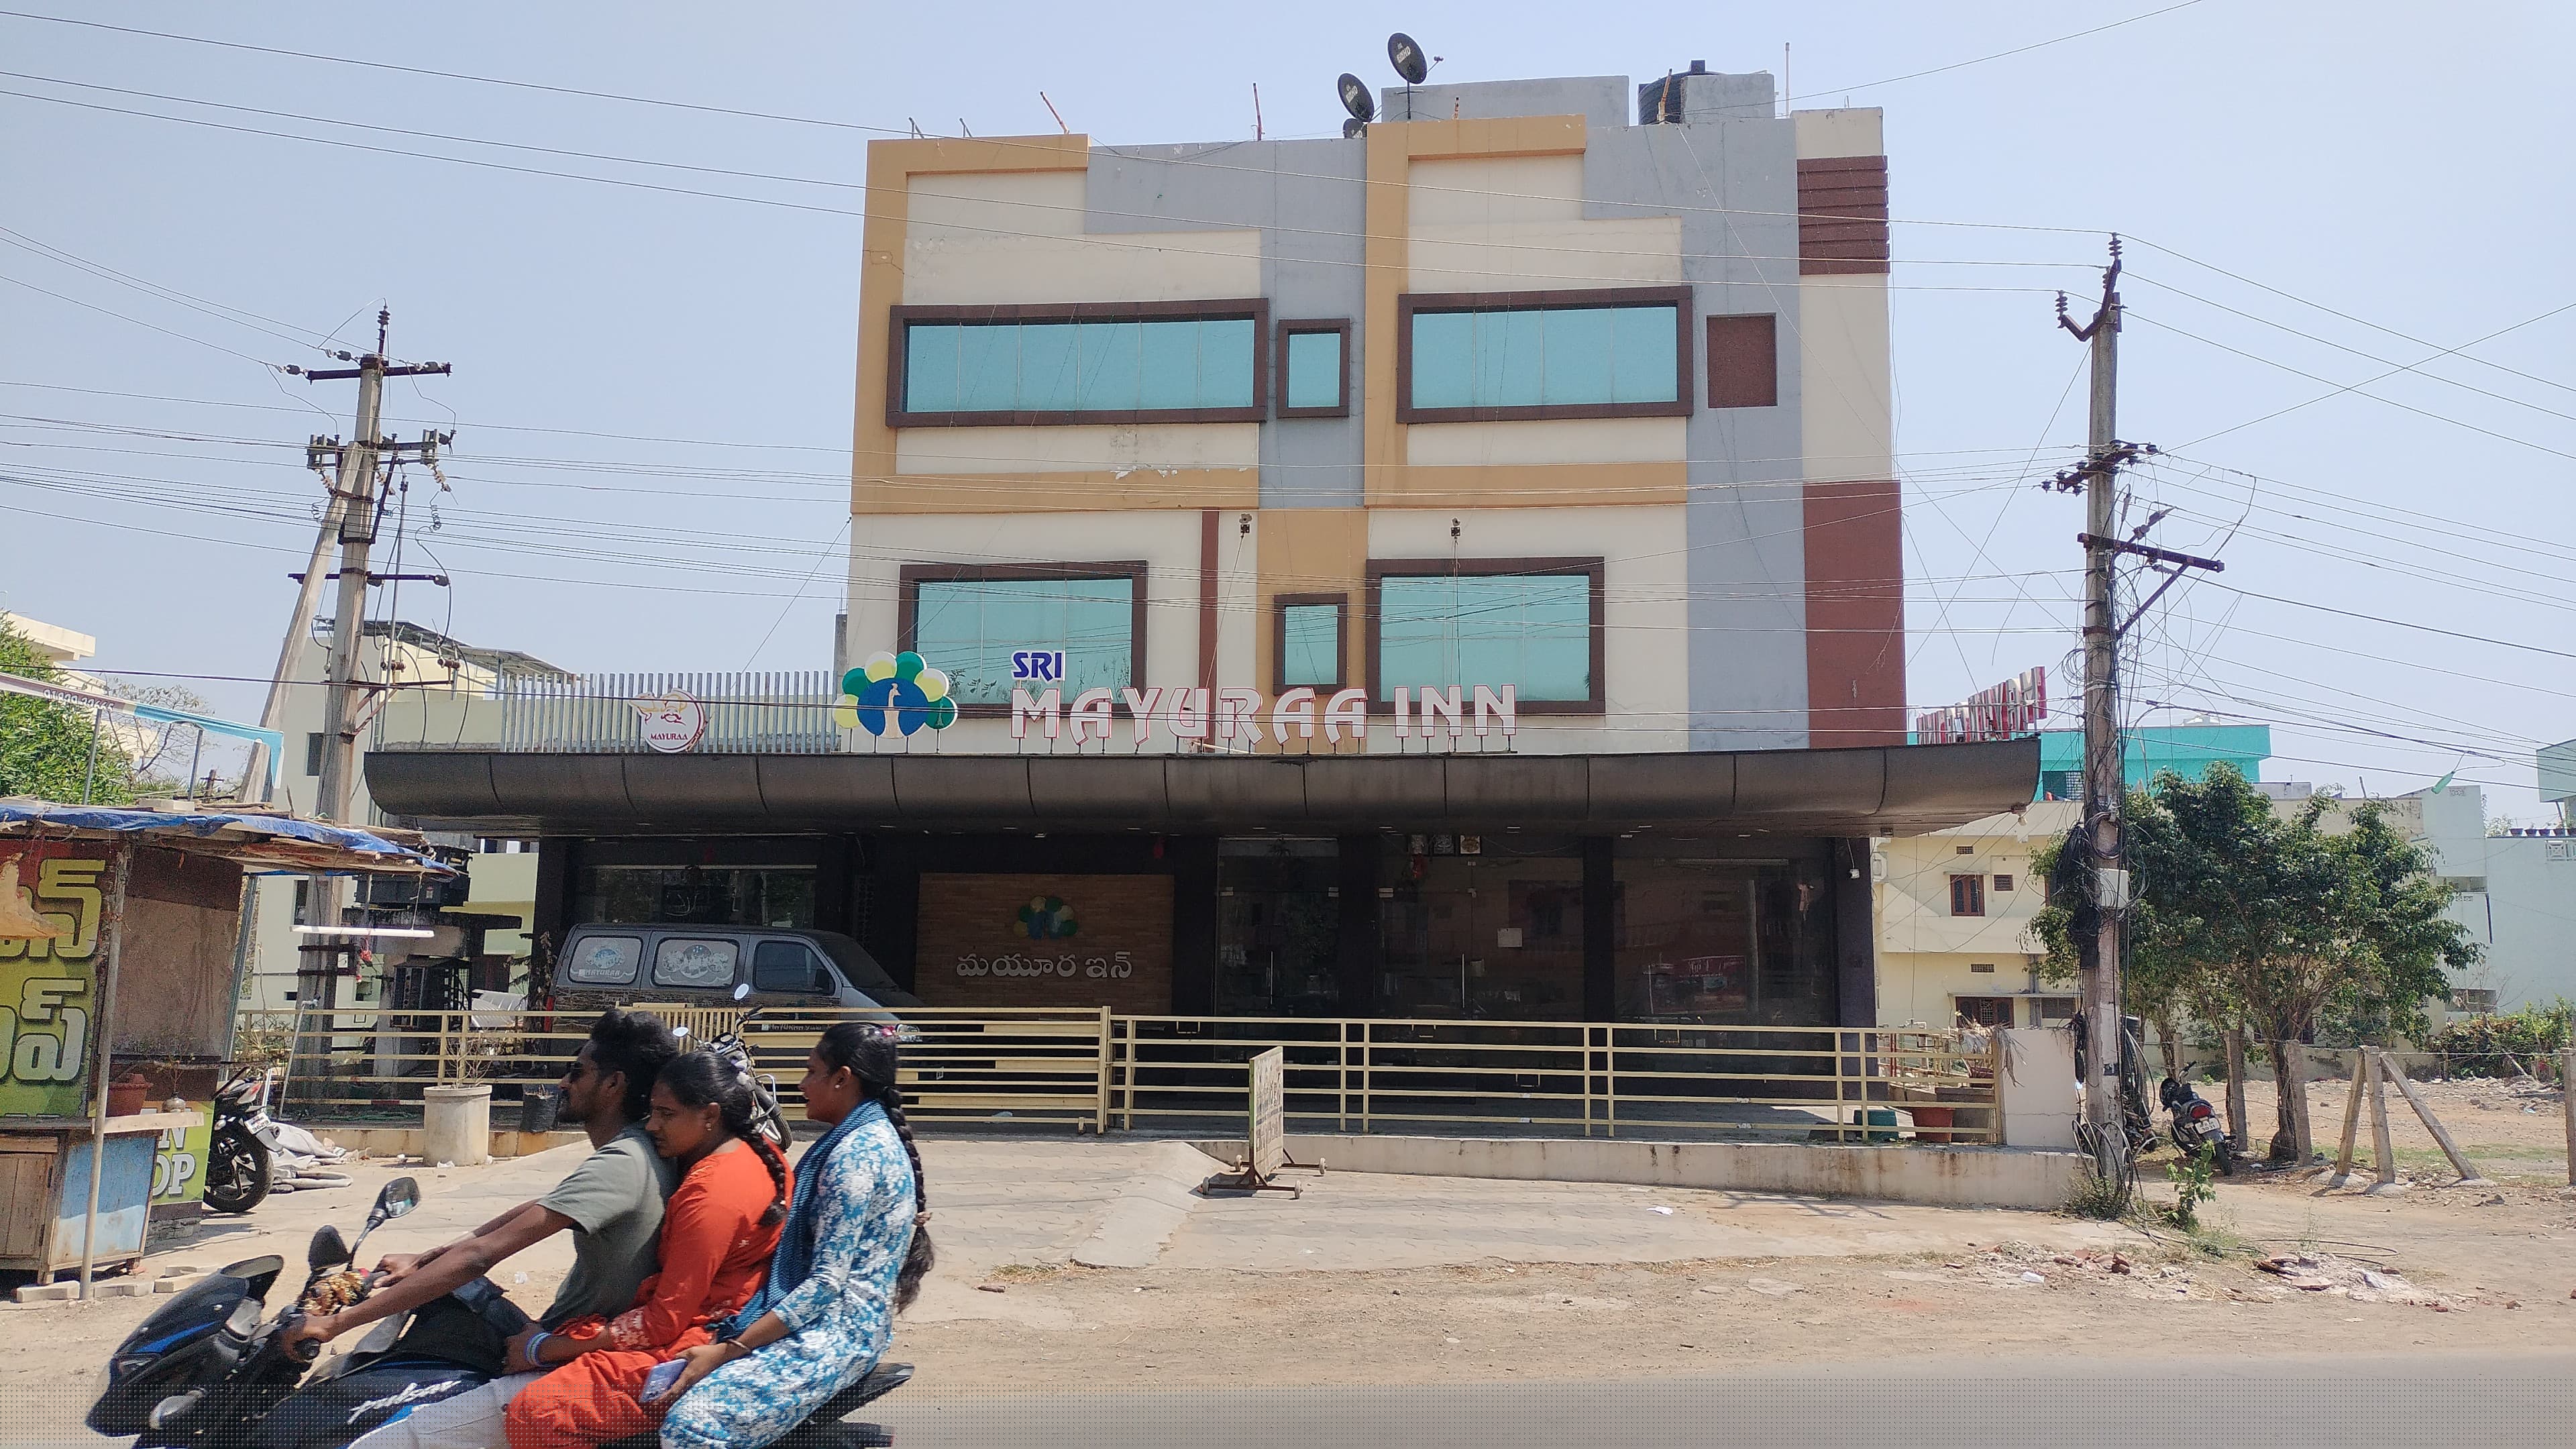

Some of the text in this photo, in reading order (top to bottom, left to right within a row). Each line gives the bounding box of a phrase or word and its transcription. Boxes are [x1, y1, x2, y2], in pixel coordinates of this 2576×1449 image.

[1012, 651, 1065, 681] SRI
[1010, 684, 1517, 745] MAYURAA INN
[1085, 951, 1133, 979] ఇన్
